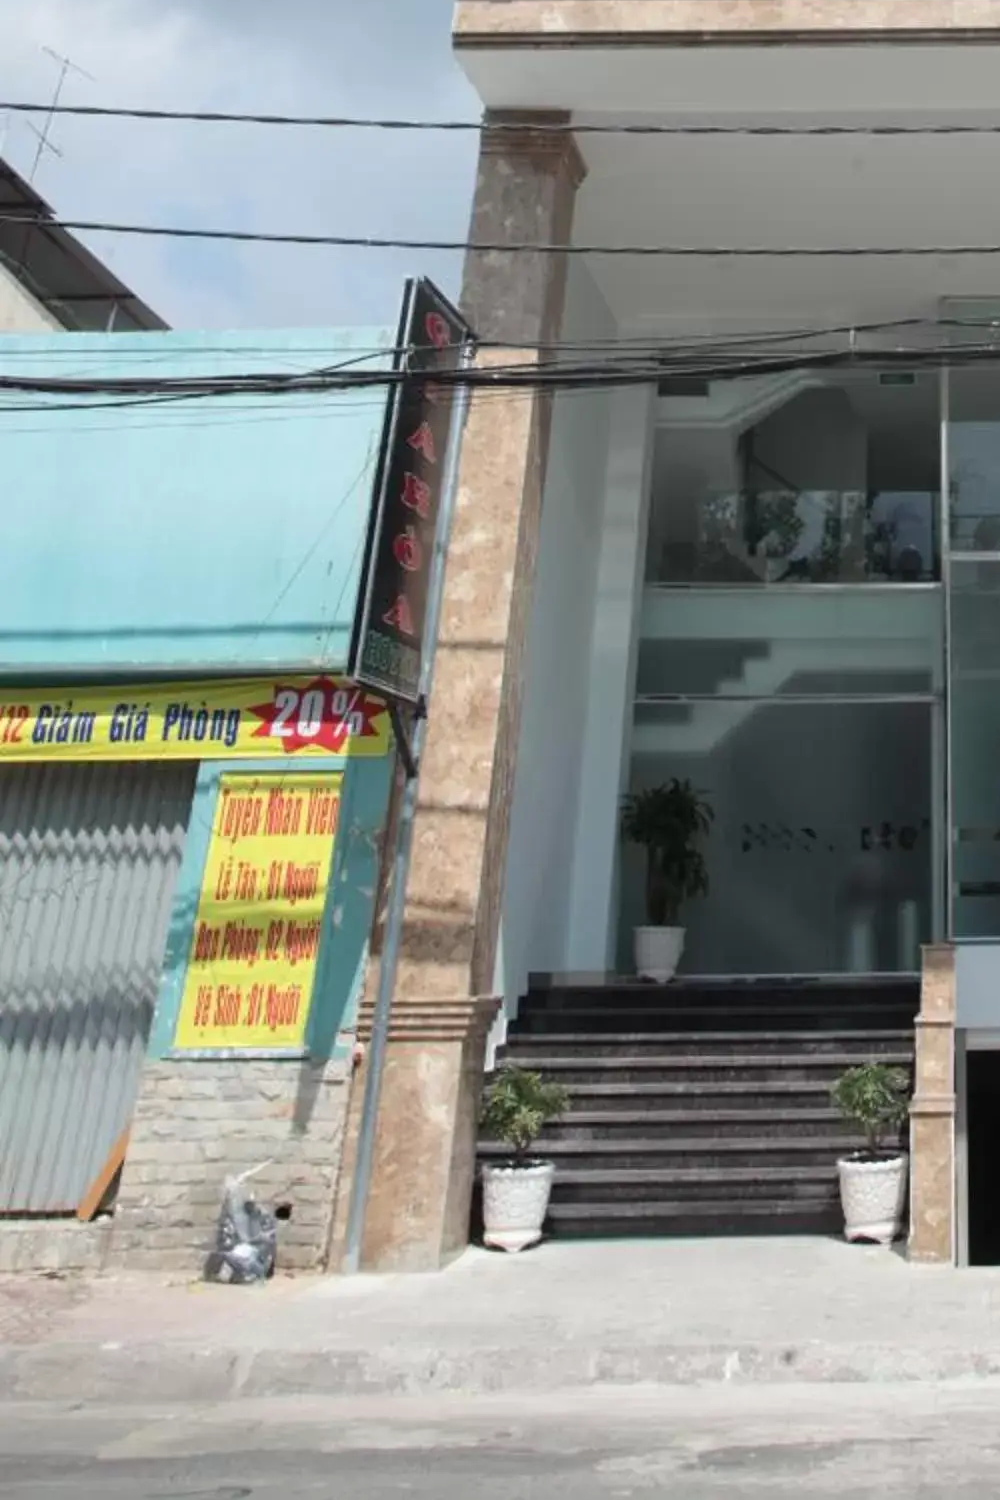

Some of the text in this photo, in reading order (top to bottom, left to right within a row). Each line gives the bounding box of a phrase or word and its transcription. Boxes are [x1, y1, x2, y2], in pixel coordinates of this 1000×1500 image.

[32, 699, 97, 743] Giảm
[109, 702, 152, 742] Giá
[162, 701, 241, 746] Phòng
[264, 786, 303, 836] Nhân
[305, 786, 339, 836] Viên
